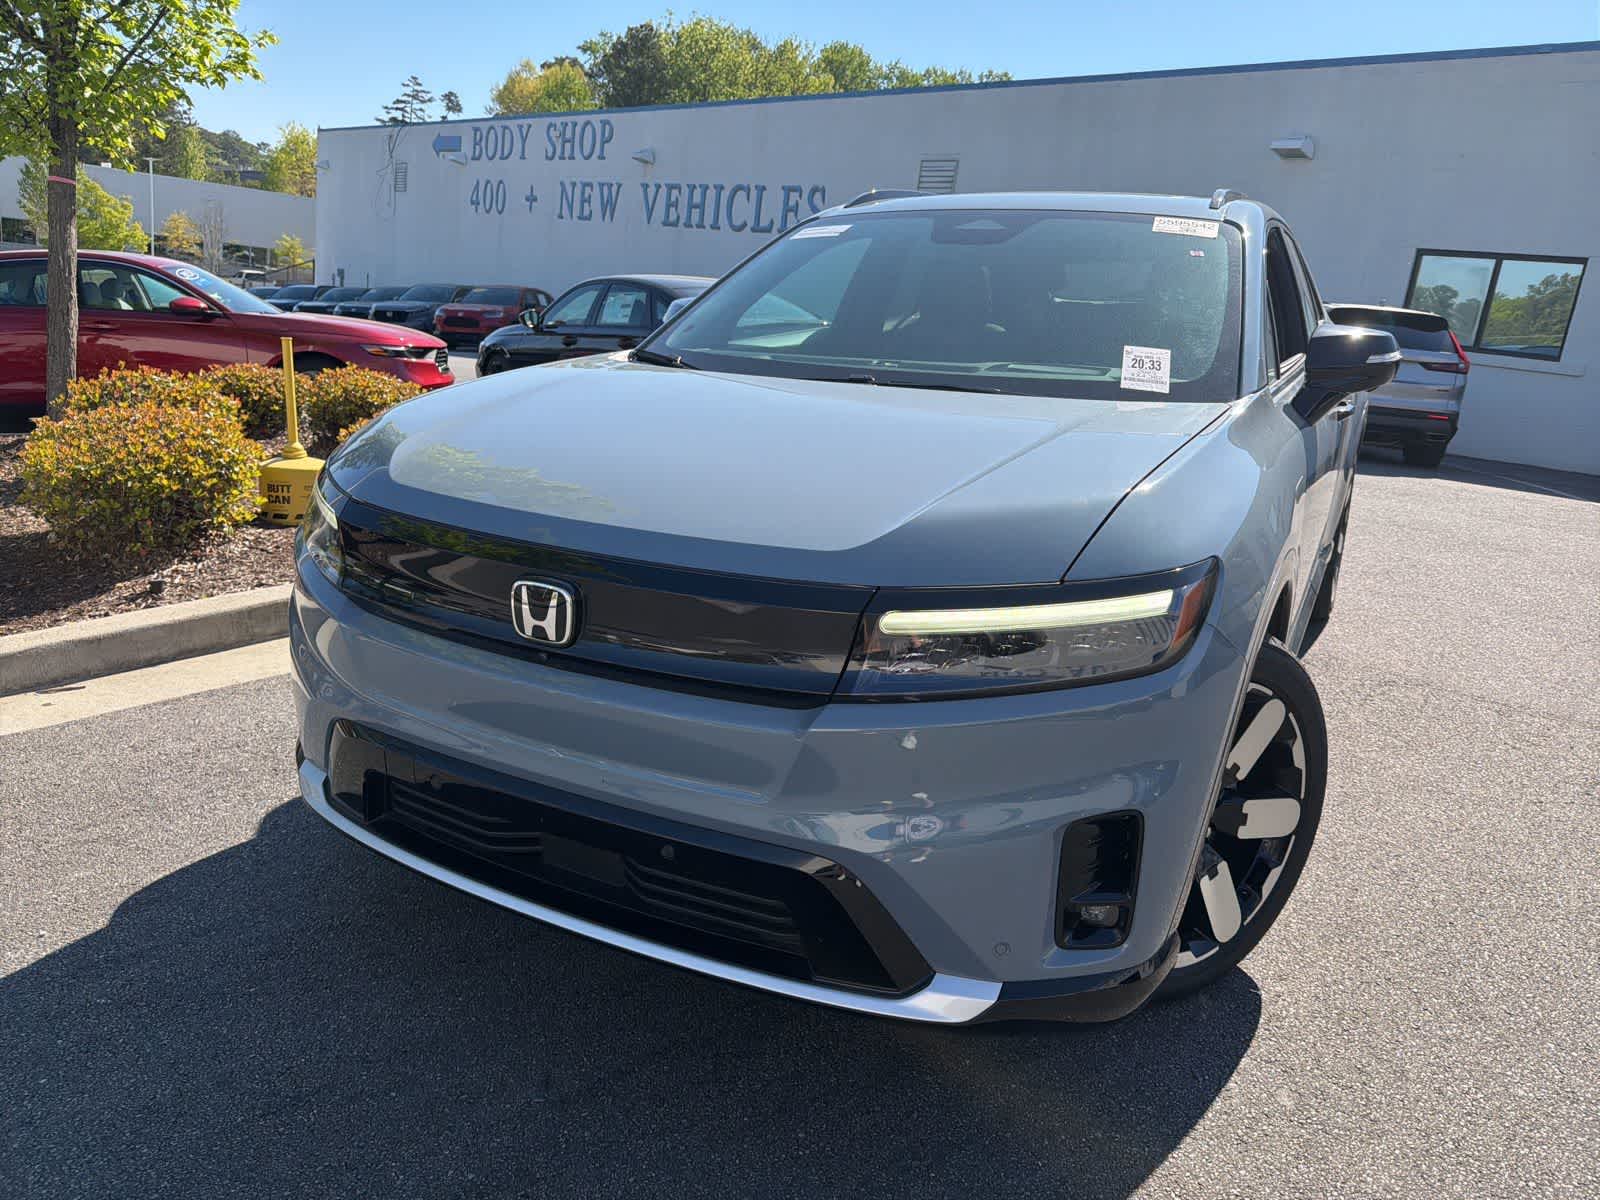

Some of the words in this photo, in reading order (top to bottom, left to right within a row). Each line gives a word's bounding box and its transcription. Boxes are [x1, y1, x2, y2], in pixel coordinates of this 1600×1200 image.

[471, 124, 532, 161] BODY
[545, 119, 614, 161] SHOP
[470, 179, 506, 215] 400
[525, 184, 538, 214] +
[557, 181, 623, 222] NEW
[640, 182, 826, 233] VEHICLES
[1131, 358, 1162, 372] 20:33
[267, 484, 292, 494] BUTT
[268, 495, 291, 505] CAN
